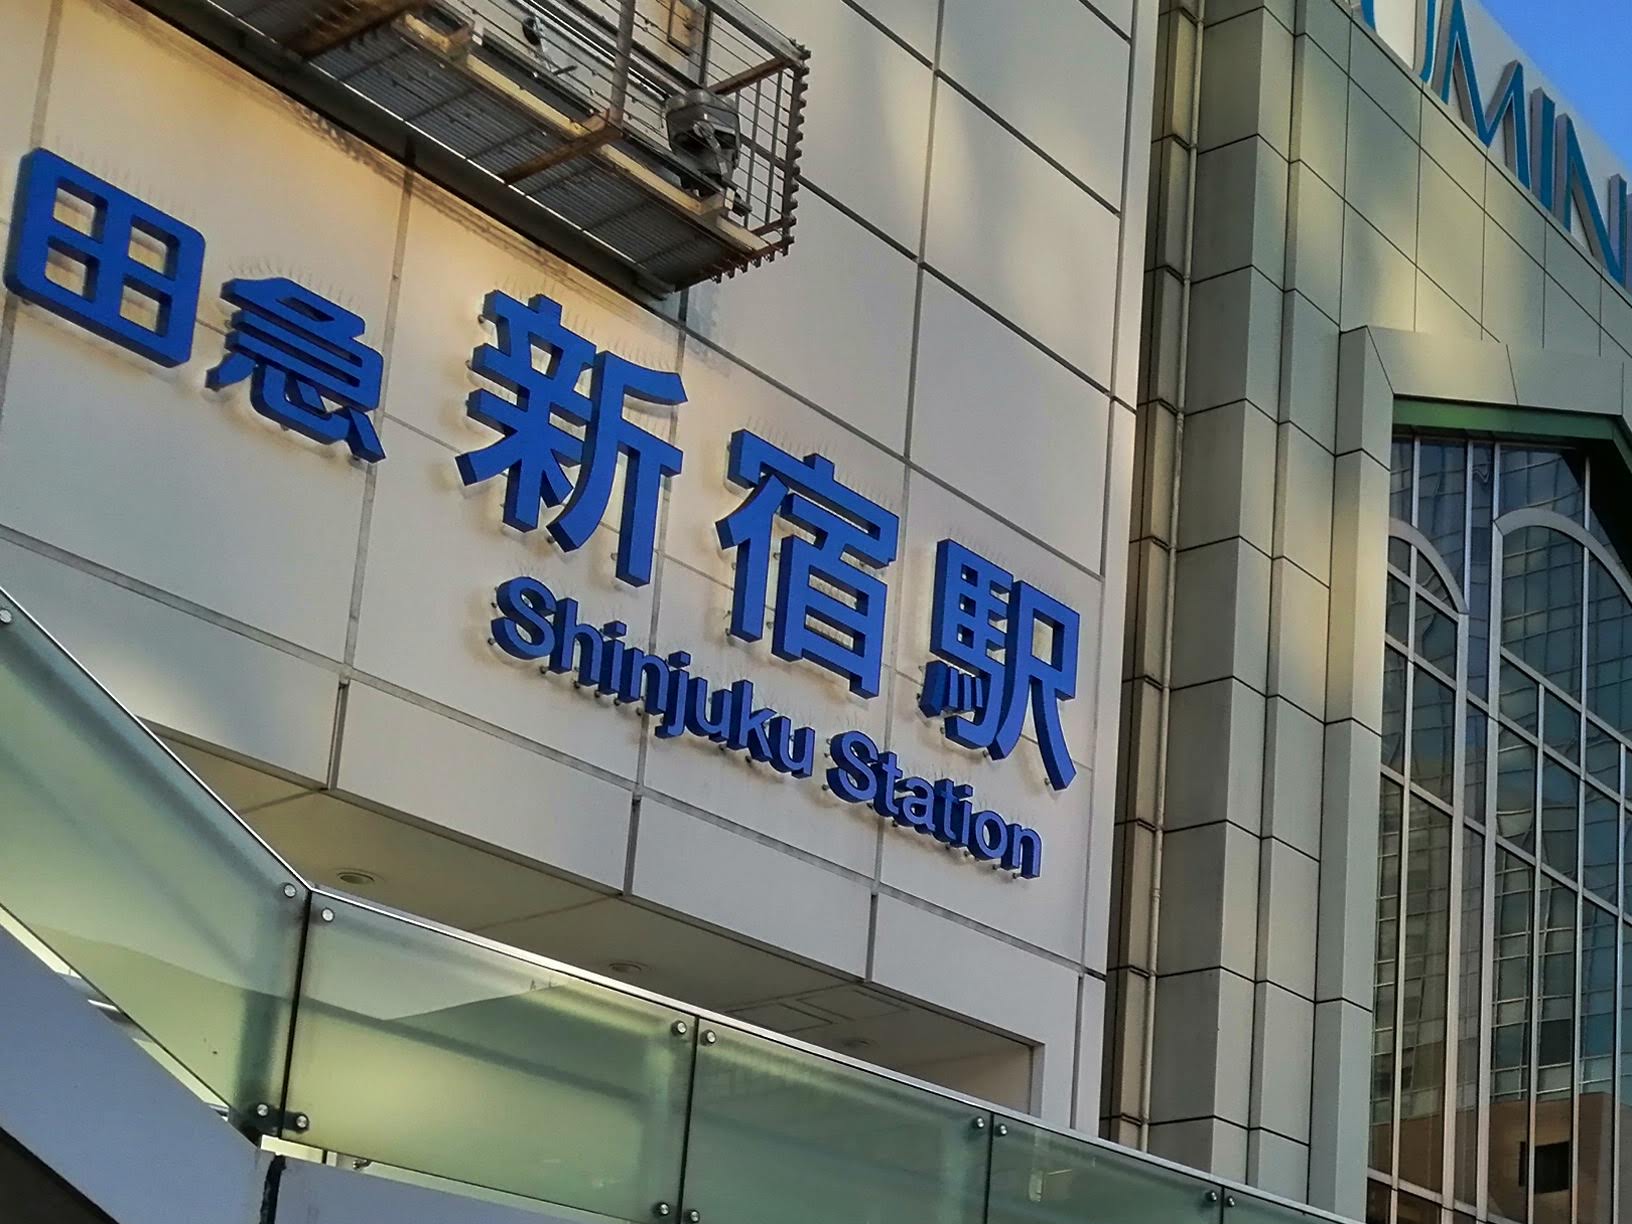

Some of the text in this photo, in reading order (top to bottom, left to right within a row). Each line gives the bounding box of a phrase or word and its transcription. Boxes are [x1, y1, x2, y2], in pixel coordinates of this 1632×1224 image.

[455, 289, 1081, 792] 新宿駅
[490, 575, 1044, 880] Shinjuku Station
